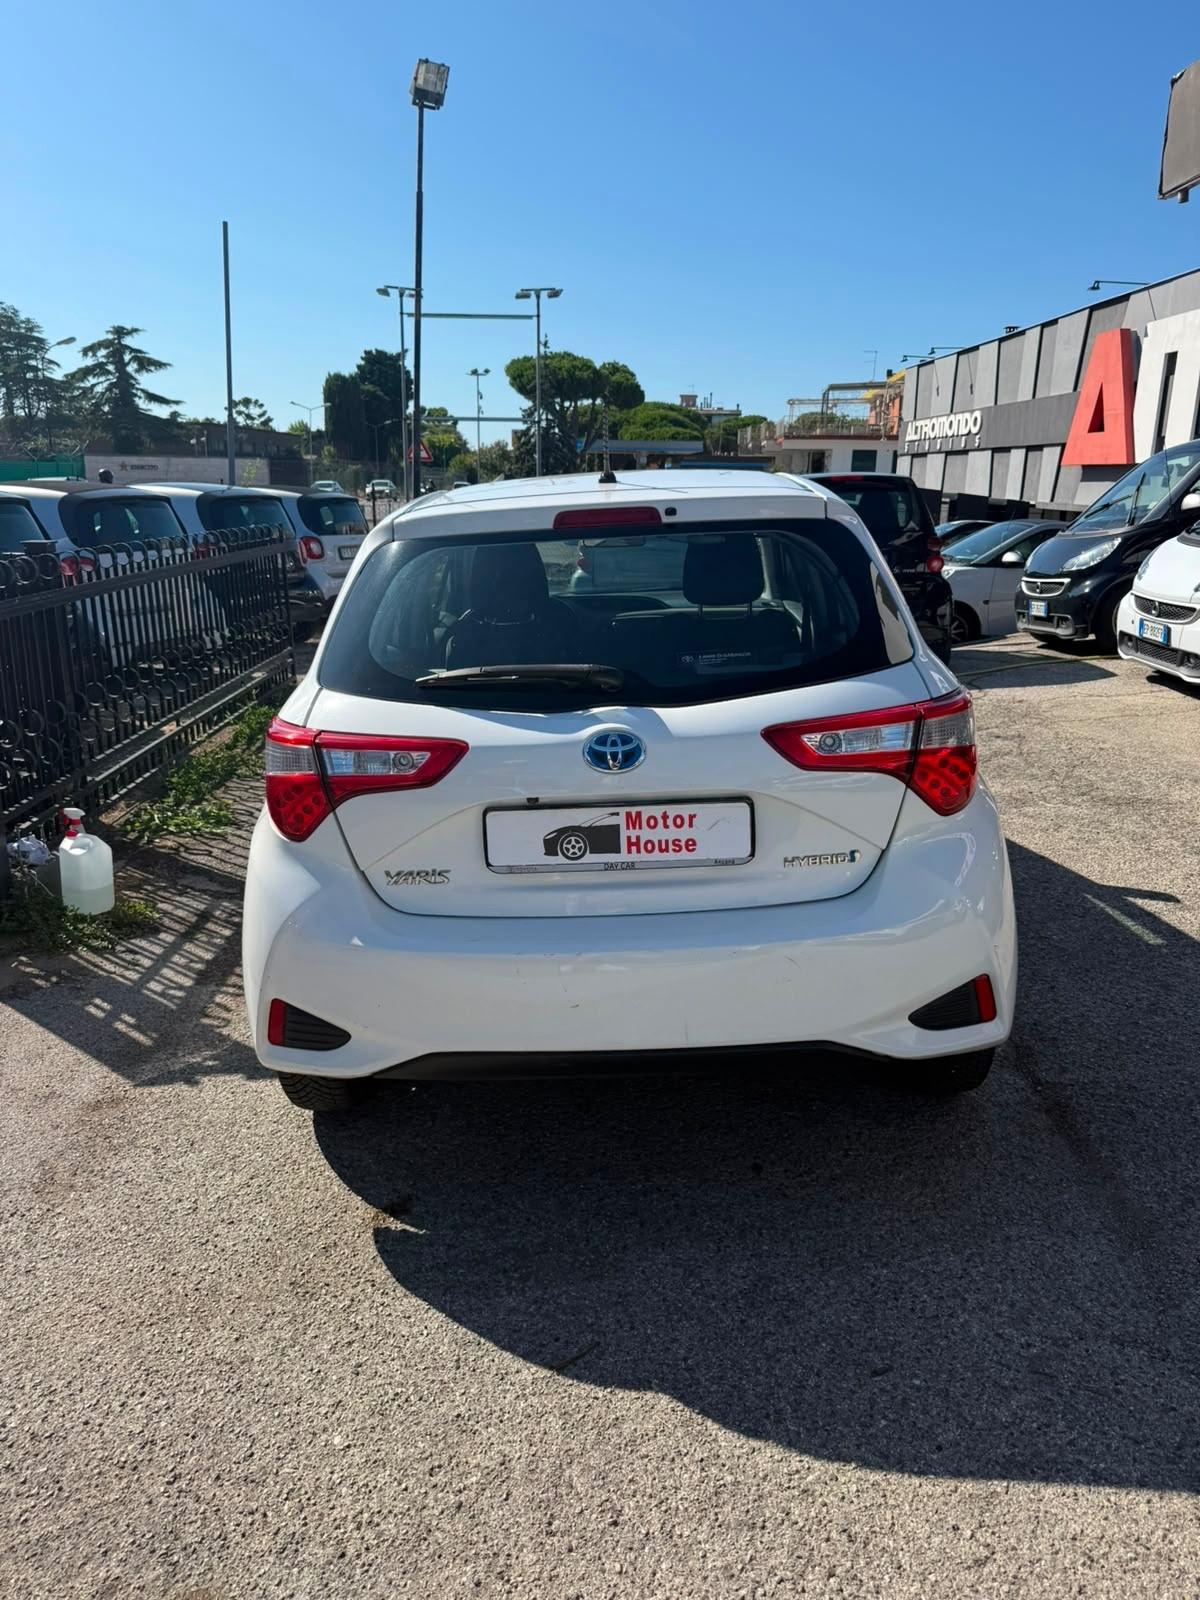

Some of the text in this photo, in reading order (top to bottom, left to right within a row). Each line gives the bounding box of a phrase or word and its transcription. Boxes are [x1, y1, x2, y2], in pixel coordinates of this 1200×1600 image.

[905, 410, 982, 442] ALTROMONDO
[625, 810, 697, 830] Motor
[626, 835, 697, 854] House
[603, 862, 636, 871] DAY CAR
[783, 853, 848, 868] HYBRID
[384, 868, 452, 885] YARIS
